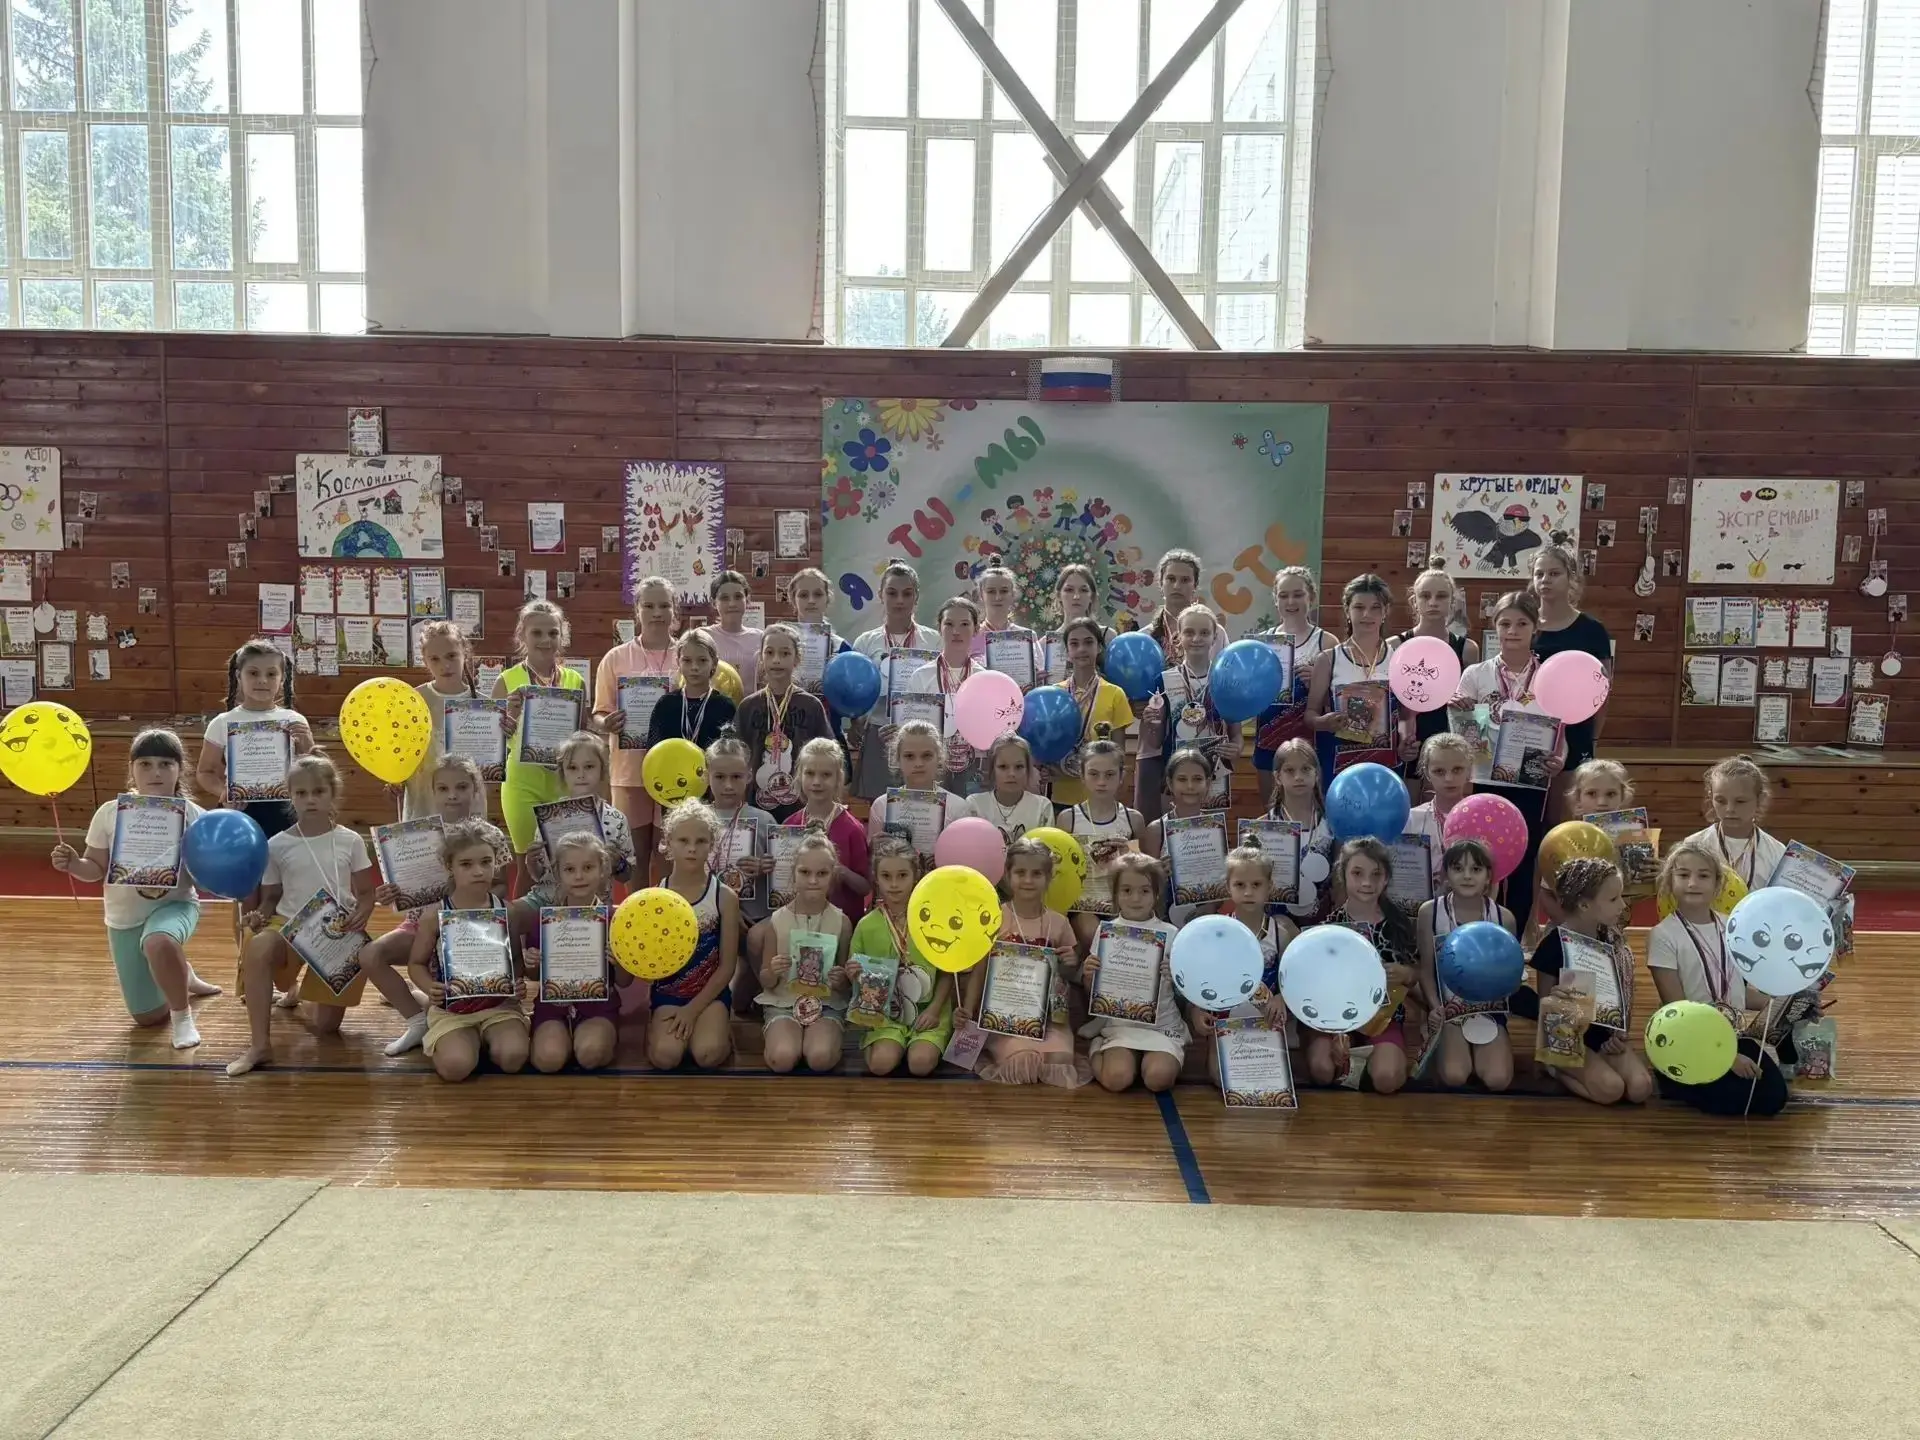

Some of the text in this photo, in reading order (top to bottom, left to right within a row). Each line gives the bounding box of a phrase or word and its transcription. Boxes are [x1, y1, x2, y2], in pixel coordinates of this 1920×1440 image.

[839, 572, 873, 611] Я
[888, 497, 955, 558] ТЫ
[974, 416, 1046, 489] МЫ
[1458, 476, 1560, 495] КРУТЫЕ ОРЛЫ
